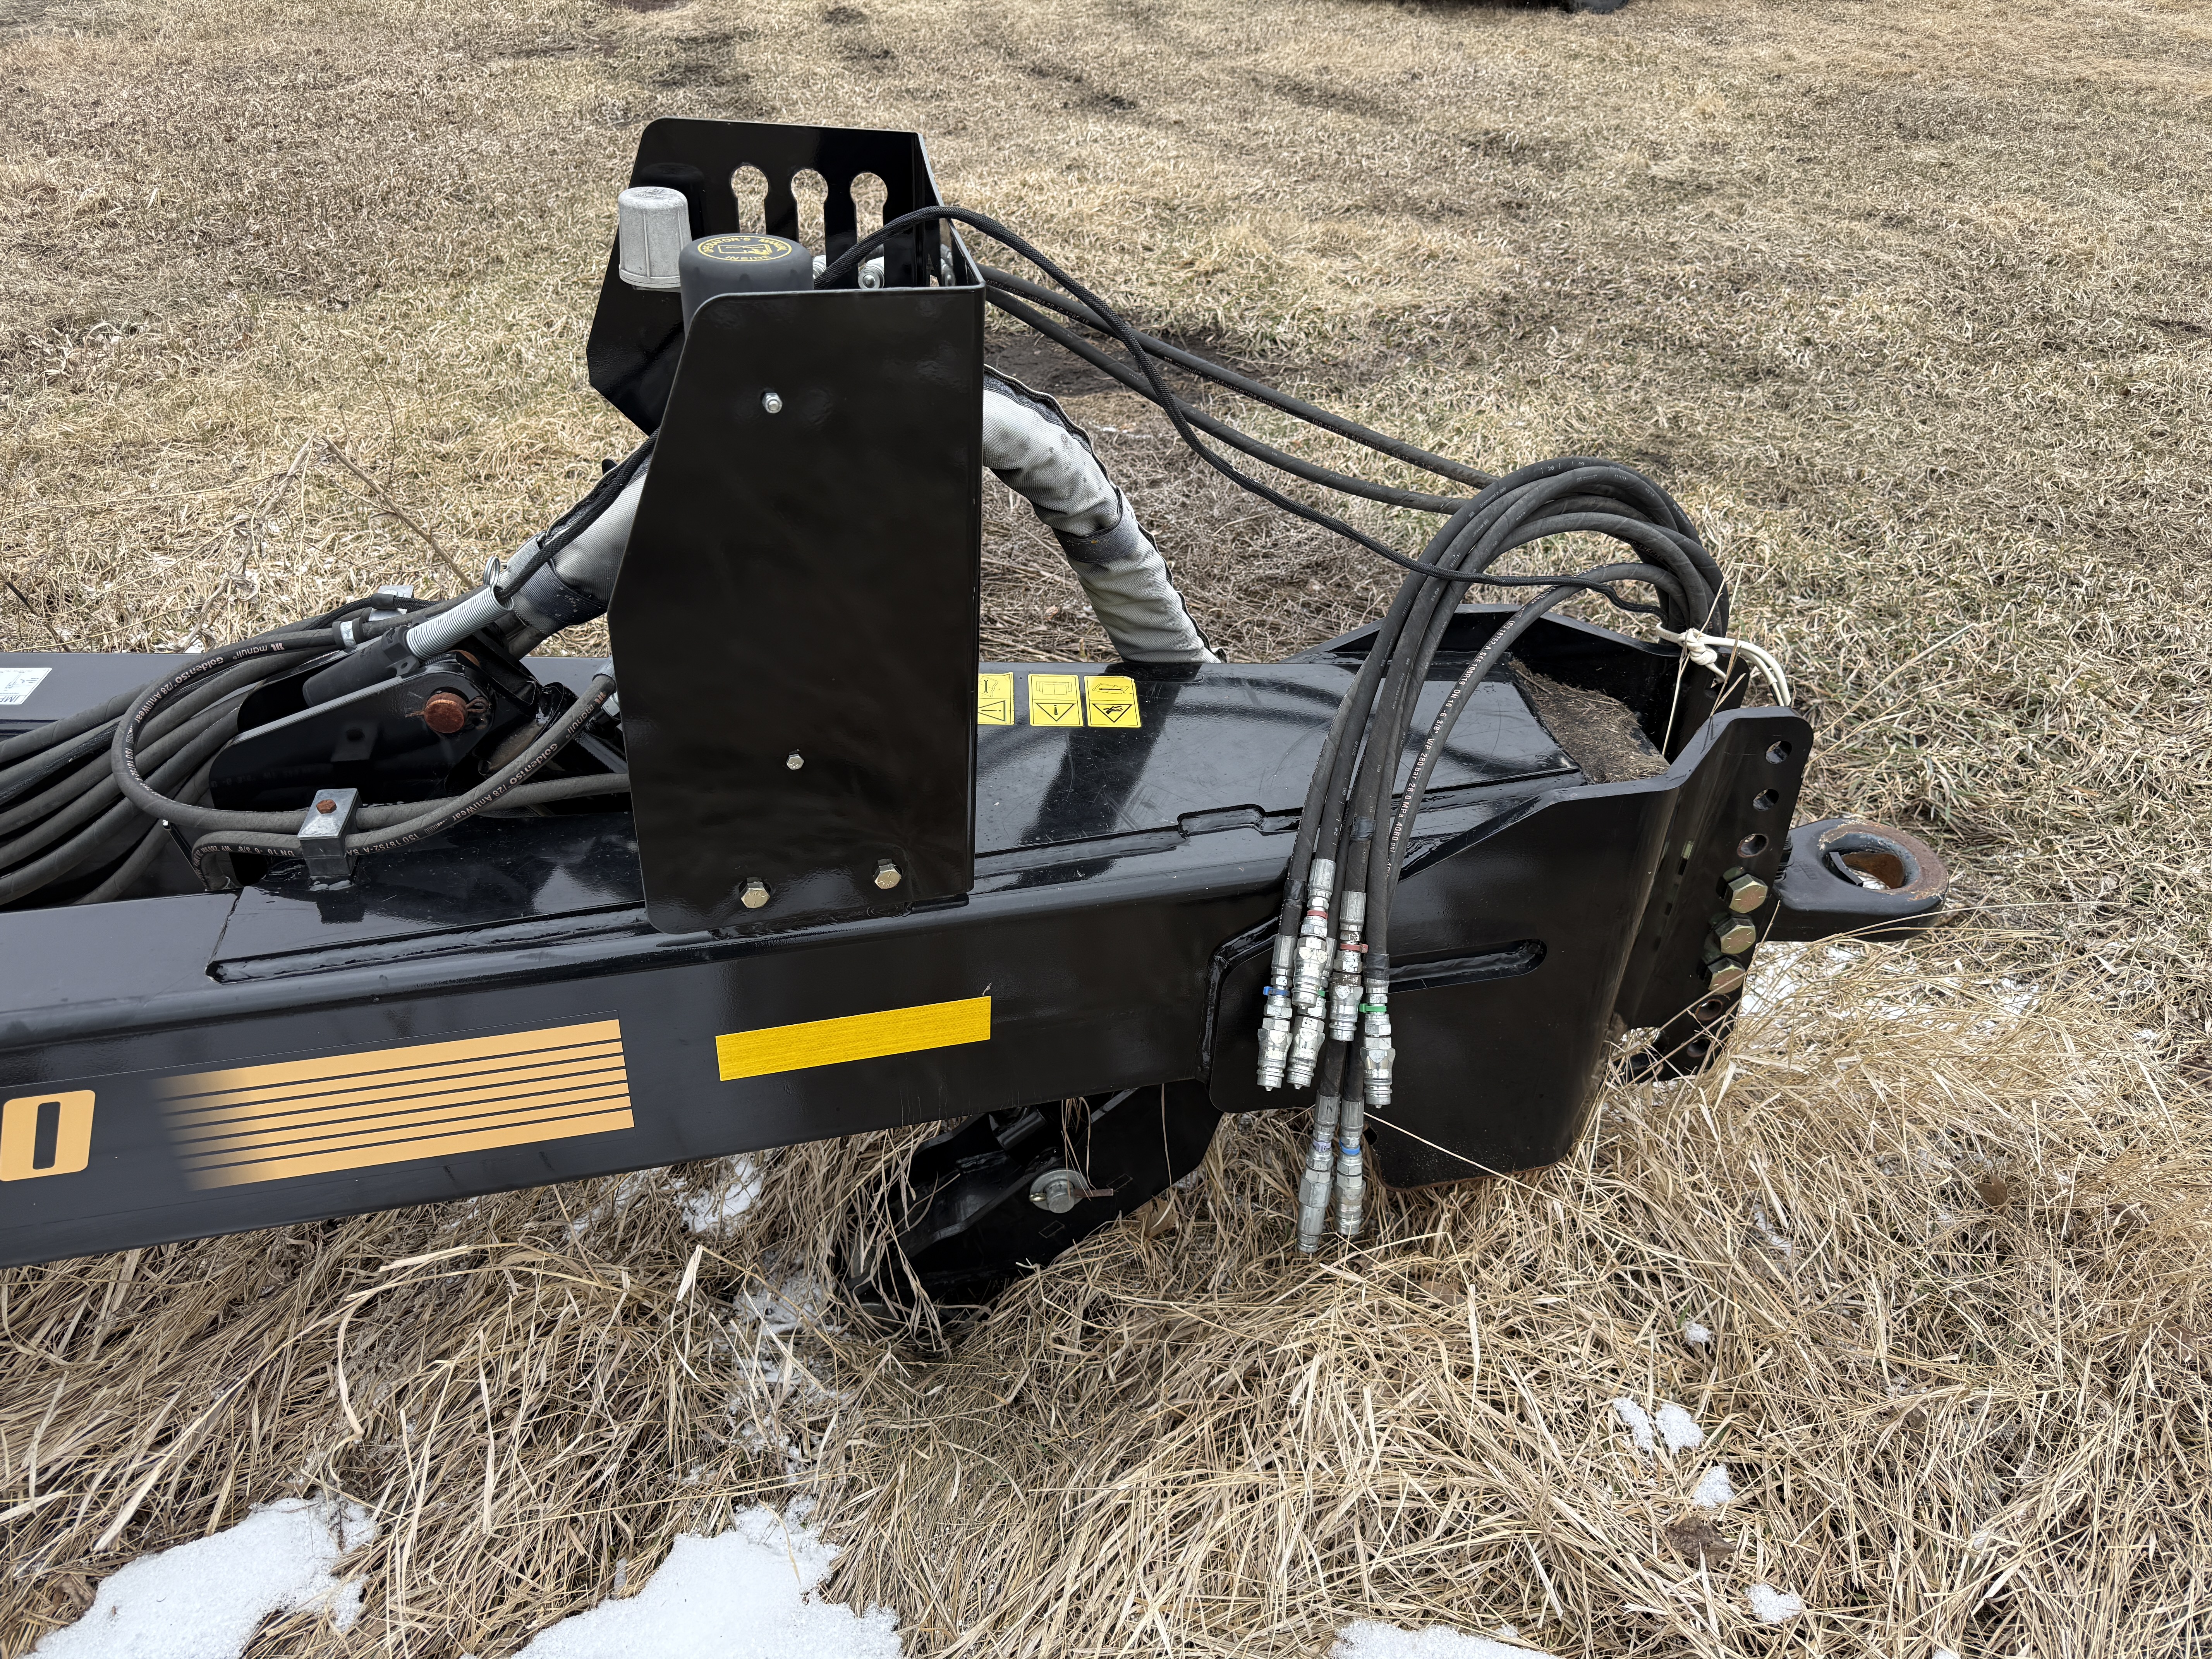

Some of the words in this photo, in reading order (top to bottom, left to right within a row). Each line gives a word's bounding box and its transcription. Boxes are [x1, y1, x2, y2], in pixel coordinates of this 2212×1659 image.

[1503, 620, 1515, 629] ISO
[1484, 629, 1506, 650] 18752-A
[1474, 651, 1487, 663] SAE
[1459, 663, 1478, 685] 100R19
[1450, 689, 1461, 698] DN
[134, 691, 162, 723] AntiWear
[1446, 699, 1454, 708] 10
[1425, 738, 1435, 750] WP
[125, 748, 134, 760] ISO
[452, 793, 492, 821] AntiWear
[402, 833, 419, 843] ISO
[363, 839, 402, 853] 18752-A
